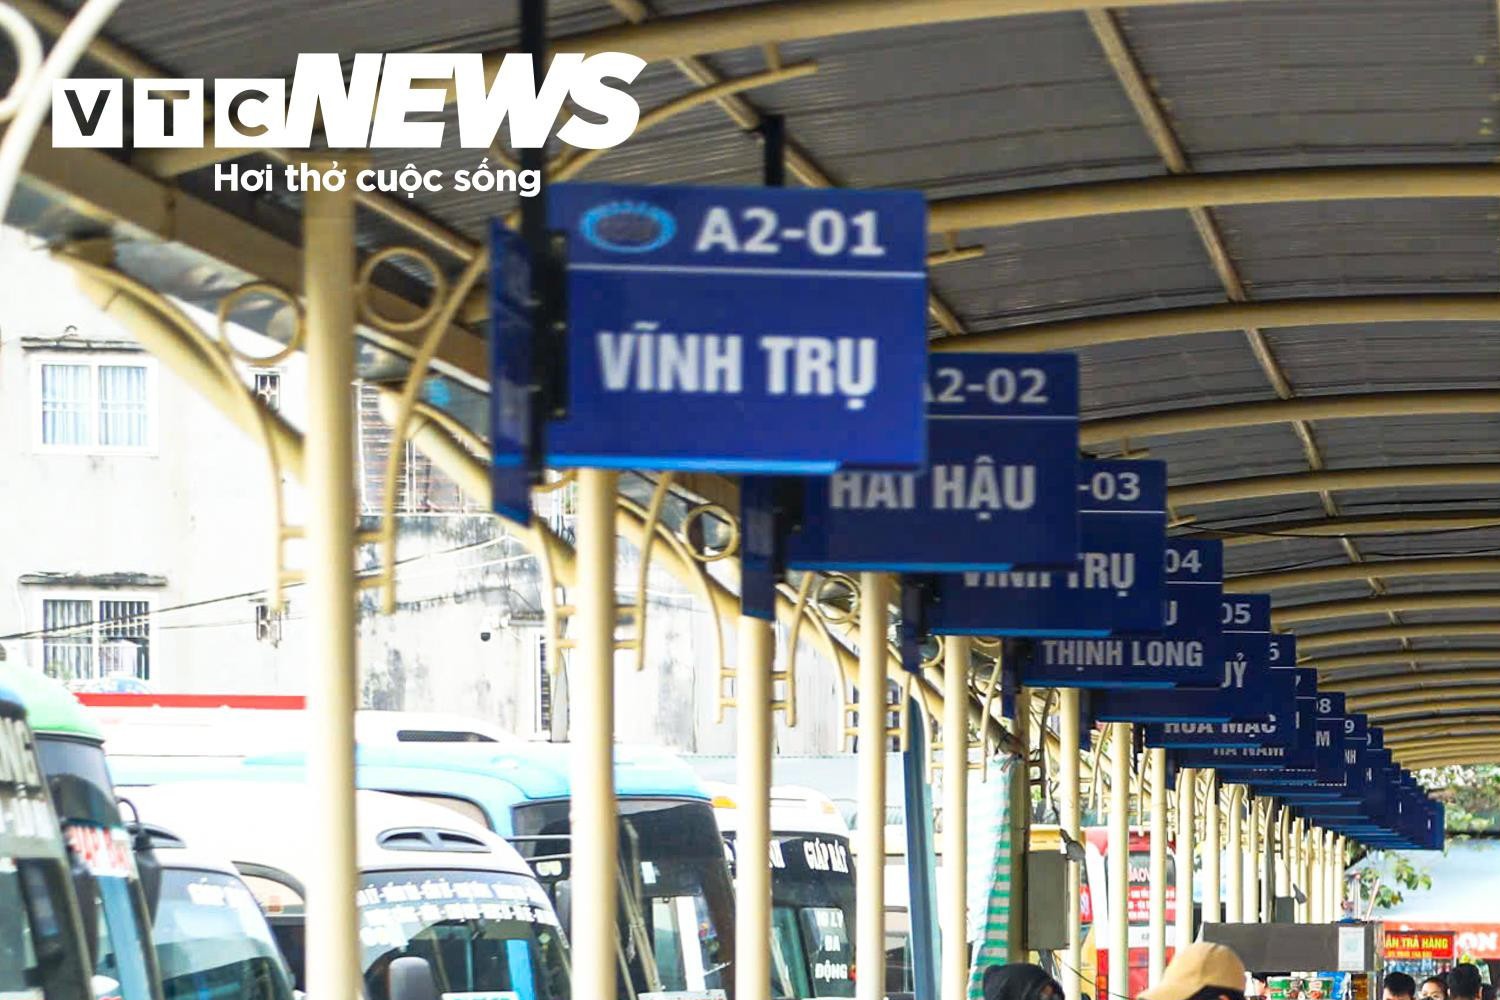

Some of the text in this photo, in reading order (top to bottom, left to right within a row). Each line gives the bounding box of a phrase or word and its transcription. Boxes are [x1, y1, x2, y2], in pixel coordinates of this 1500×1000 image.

[695, 207, 885, 256] A2-01
[600, 321, 876, 410] VĨNH TRỤ
[926, 367, 1048, 404] 2-02
[932, 455, 1036, 520] HẬU
[1043, 638, 1203, 672] THỊNH LONG
